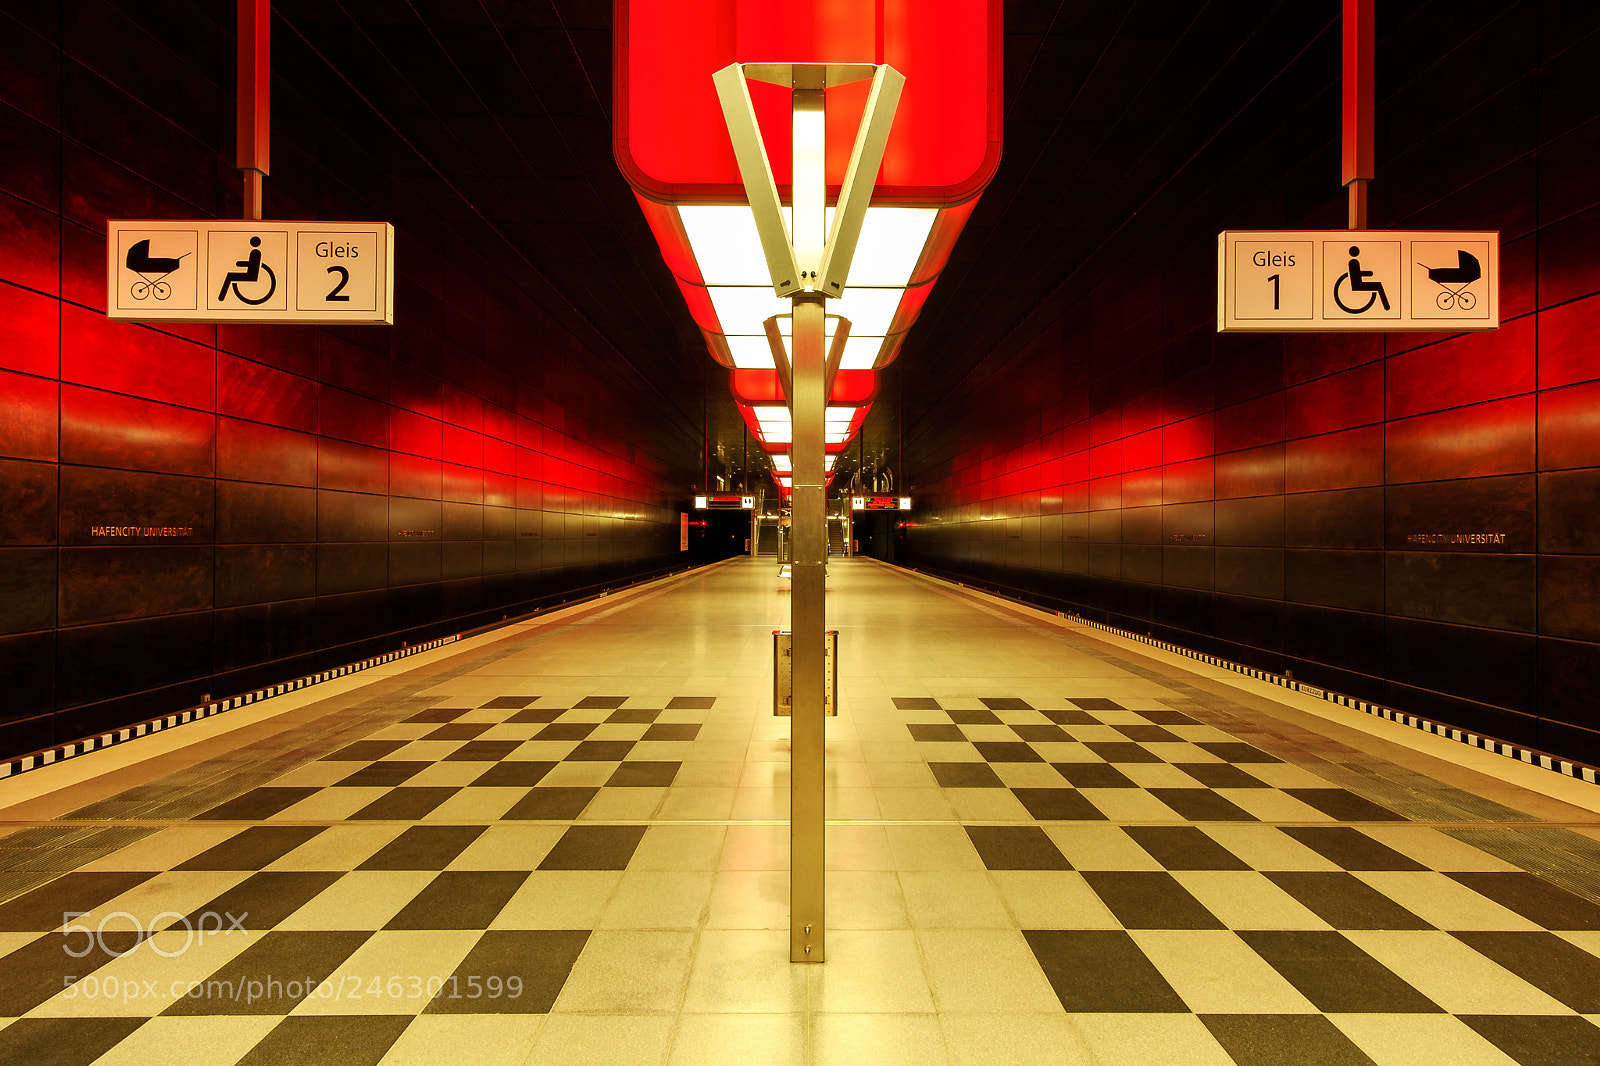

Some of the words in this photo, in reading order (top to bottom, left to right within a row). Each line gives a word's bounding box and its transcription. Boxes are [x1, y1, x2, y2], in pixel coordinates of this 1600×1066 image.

[315, 241, 359, 258] Gleis
[1253, 250, 1296, 267] Gleis
[325, 265, 350, 302] 2
[1267, 274, 1280, 310] 1
[91, 526, 141, 537] HAFENCITY
[1450, 533, 1506, 544] UNIVERSITÄT
